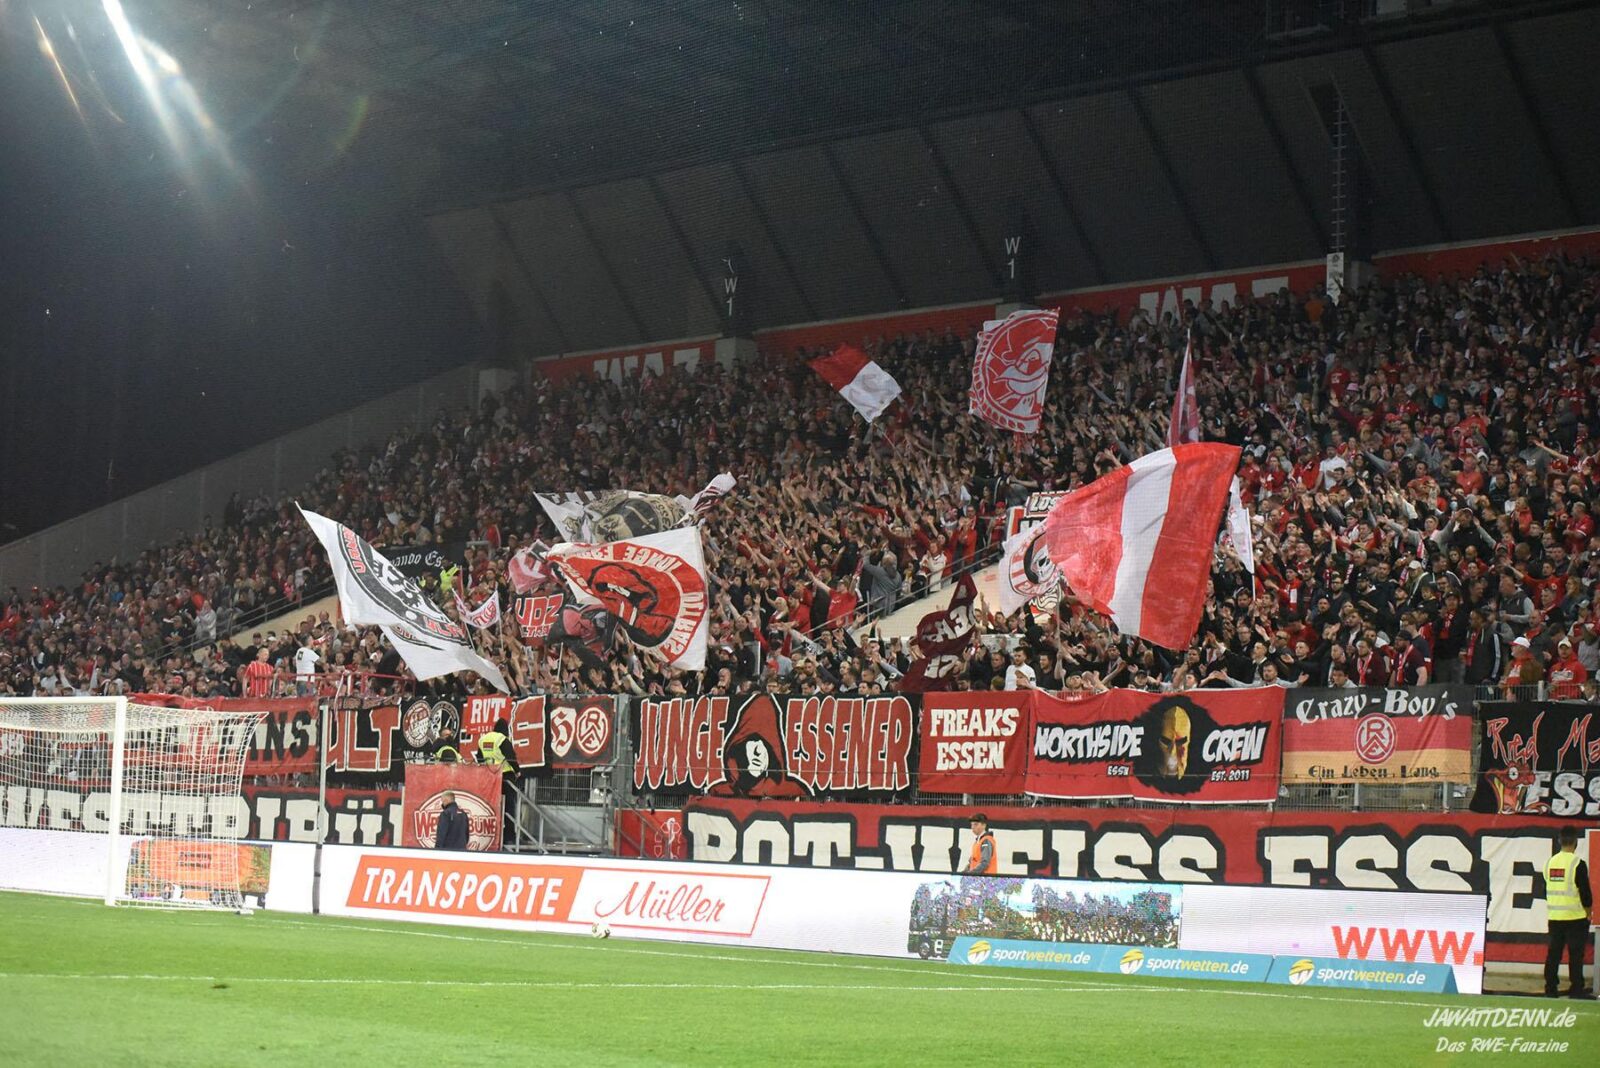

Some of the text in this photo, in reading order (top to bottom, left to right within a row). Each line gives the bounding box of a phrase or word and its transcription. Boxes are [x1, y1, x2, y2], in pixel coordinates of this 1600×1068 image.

[1005, 236, 1021, 255] W
[1008, 258, 1015, 279] 1
[724, 276, 738, 294] W
[930, 708, 1020, 737] FREAKS
[634, 697, 731, 790] JUNGE
[786, 697, 912, 791] ESSENER
[936, 741, 1006, 771] ESSEN
[1034, 725, 1267, 764] NORTHSIDE CREW
[1229, 769, 1250, 781] 2011
[361, 867, 726, 922] TRANSPORTE Müller
[992, 948, 1091, 965] sportwetten.de
[1331, 925, 1484, 966] www.
[1146, 957, 1249, 975] sportwetten.de
[1316, 967, 1426, 985] sportwetten.de
